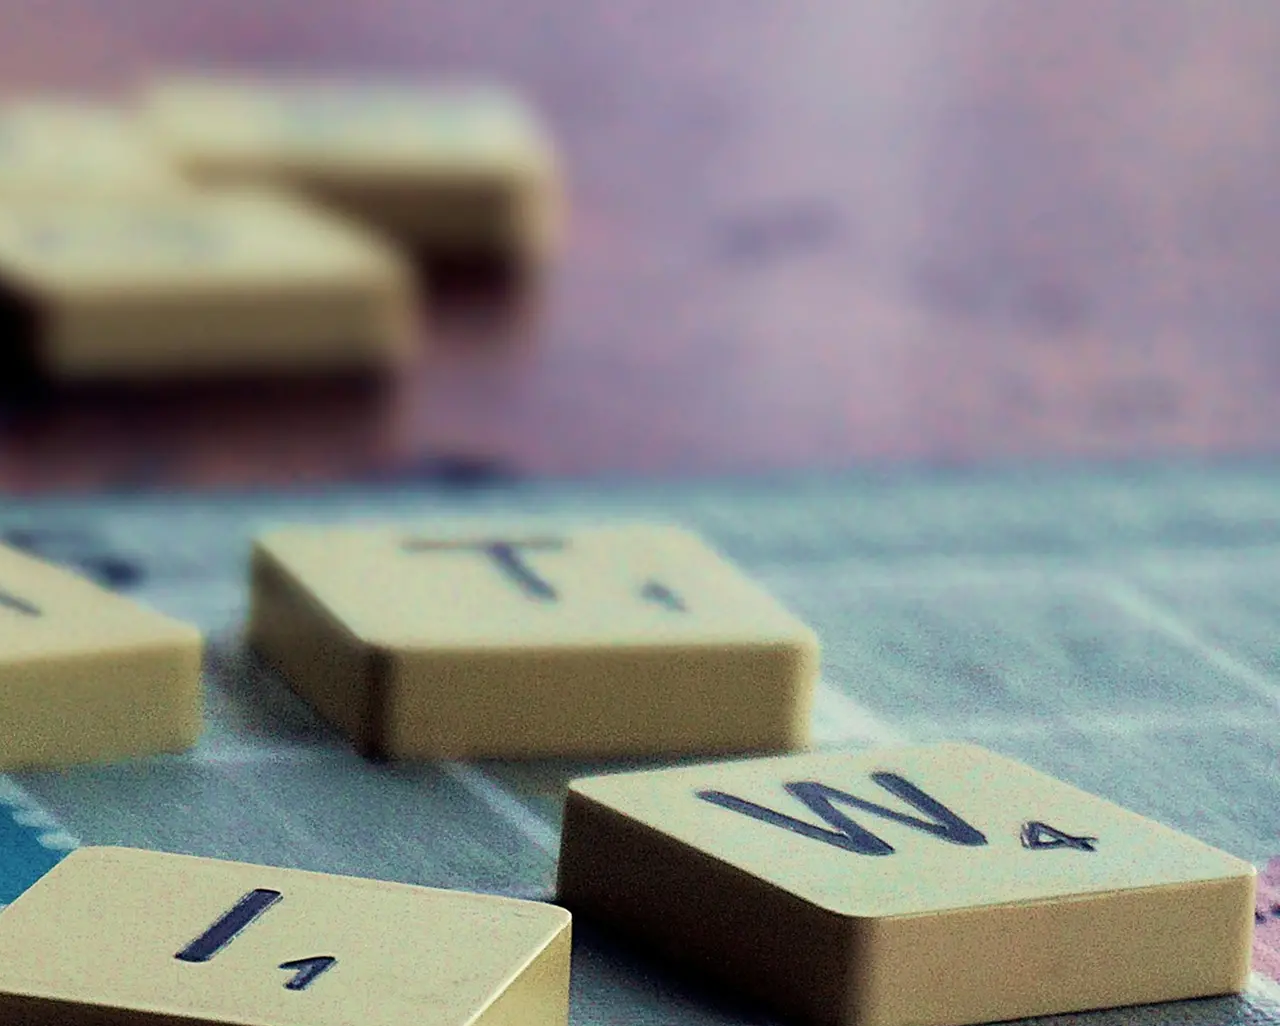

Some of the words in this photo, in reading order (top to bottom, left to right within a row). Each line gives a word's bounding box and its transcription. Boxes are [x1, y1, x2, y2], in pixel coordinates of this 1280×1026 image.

[398, 535, 568, 602] T
[695, 770, 990, 858] W
[1020, 819, 1101, 854] 4
[172, 887, 285, 964] I
[277, 955, 339, 992] 1
